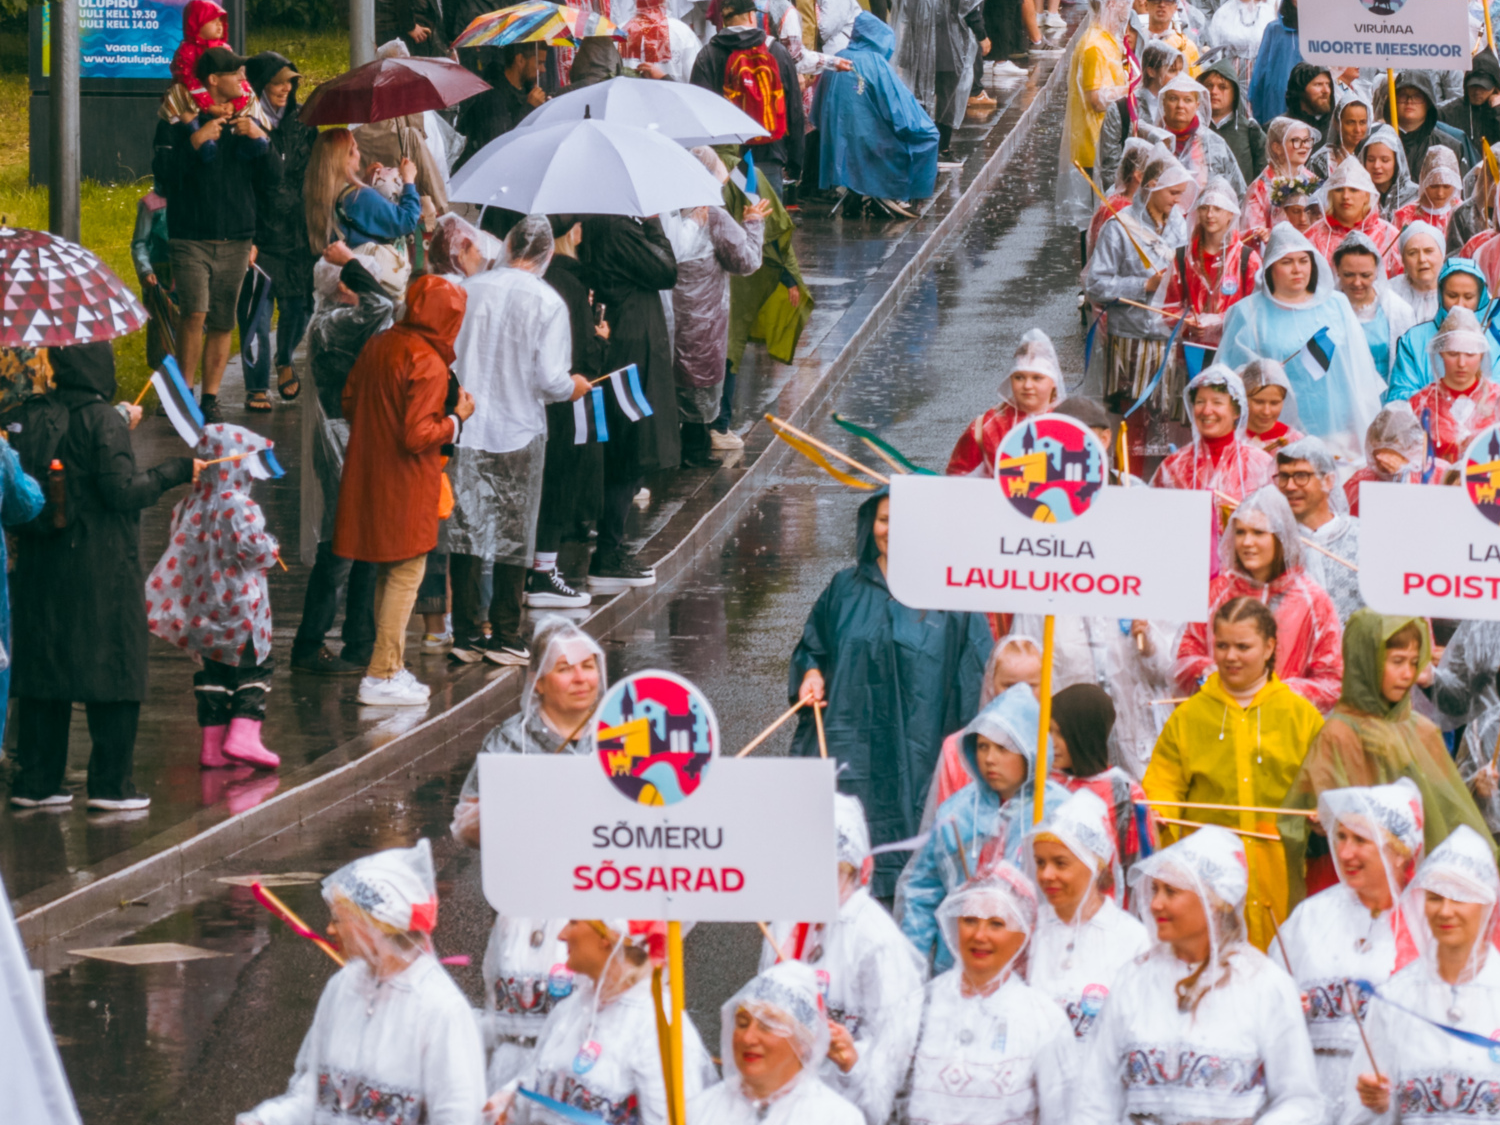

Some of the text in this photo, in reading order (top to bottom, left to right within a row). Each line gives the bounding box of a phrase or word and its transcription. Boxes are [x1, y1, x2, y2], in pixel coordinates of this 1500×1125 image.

[106, 10, 130, 19] KELL
[131, 11, 159, 19] 19.30
[106, 20, 130, 29] KELL
[131, 21, 159, 29] 14.00
[1353, 23, 1414, 35] VIRUMAA
[105, 42, 163, 54] Vaata lisa:
[1308, 39, 1462, 58] NOORTE MEESKOOR
[83, 54, 173, 66] www.laulupidu.
[999, 536, 1095, 560] LASILA
[945, 566, 1142, 597] LAULUKOOR
[592, 820, 724, 850] SÕMERU
[572, 860, 746, 893] SÕSARAD
